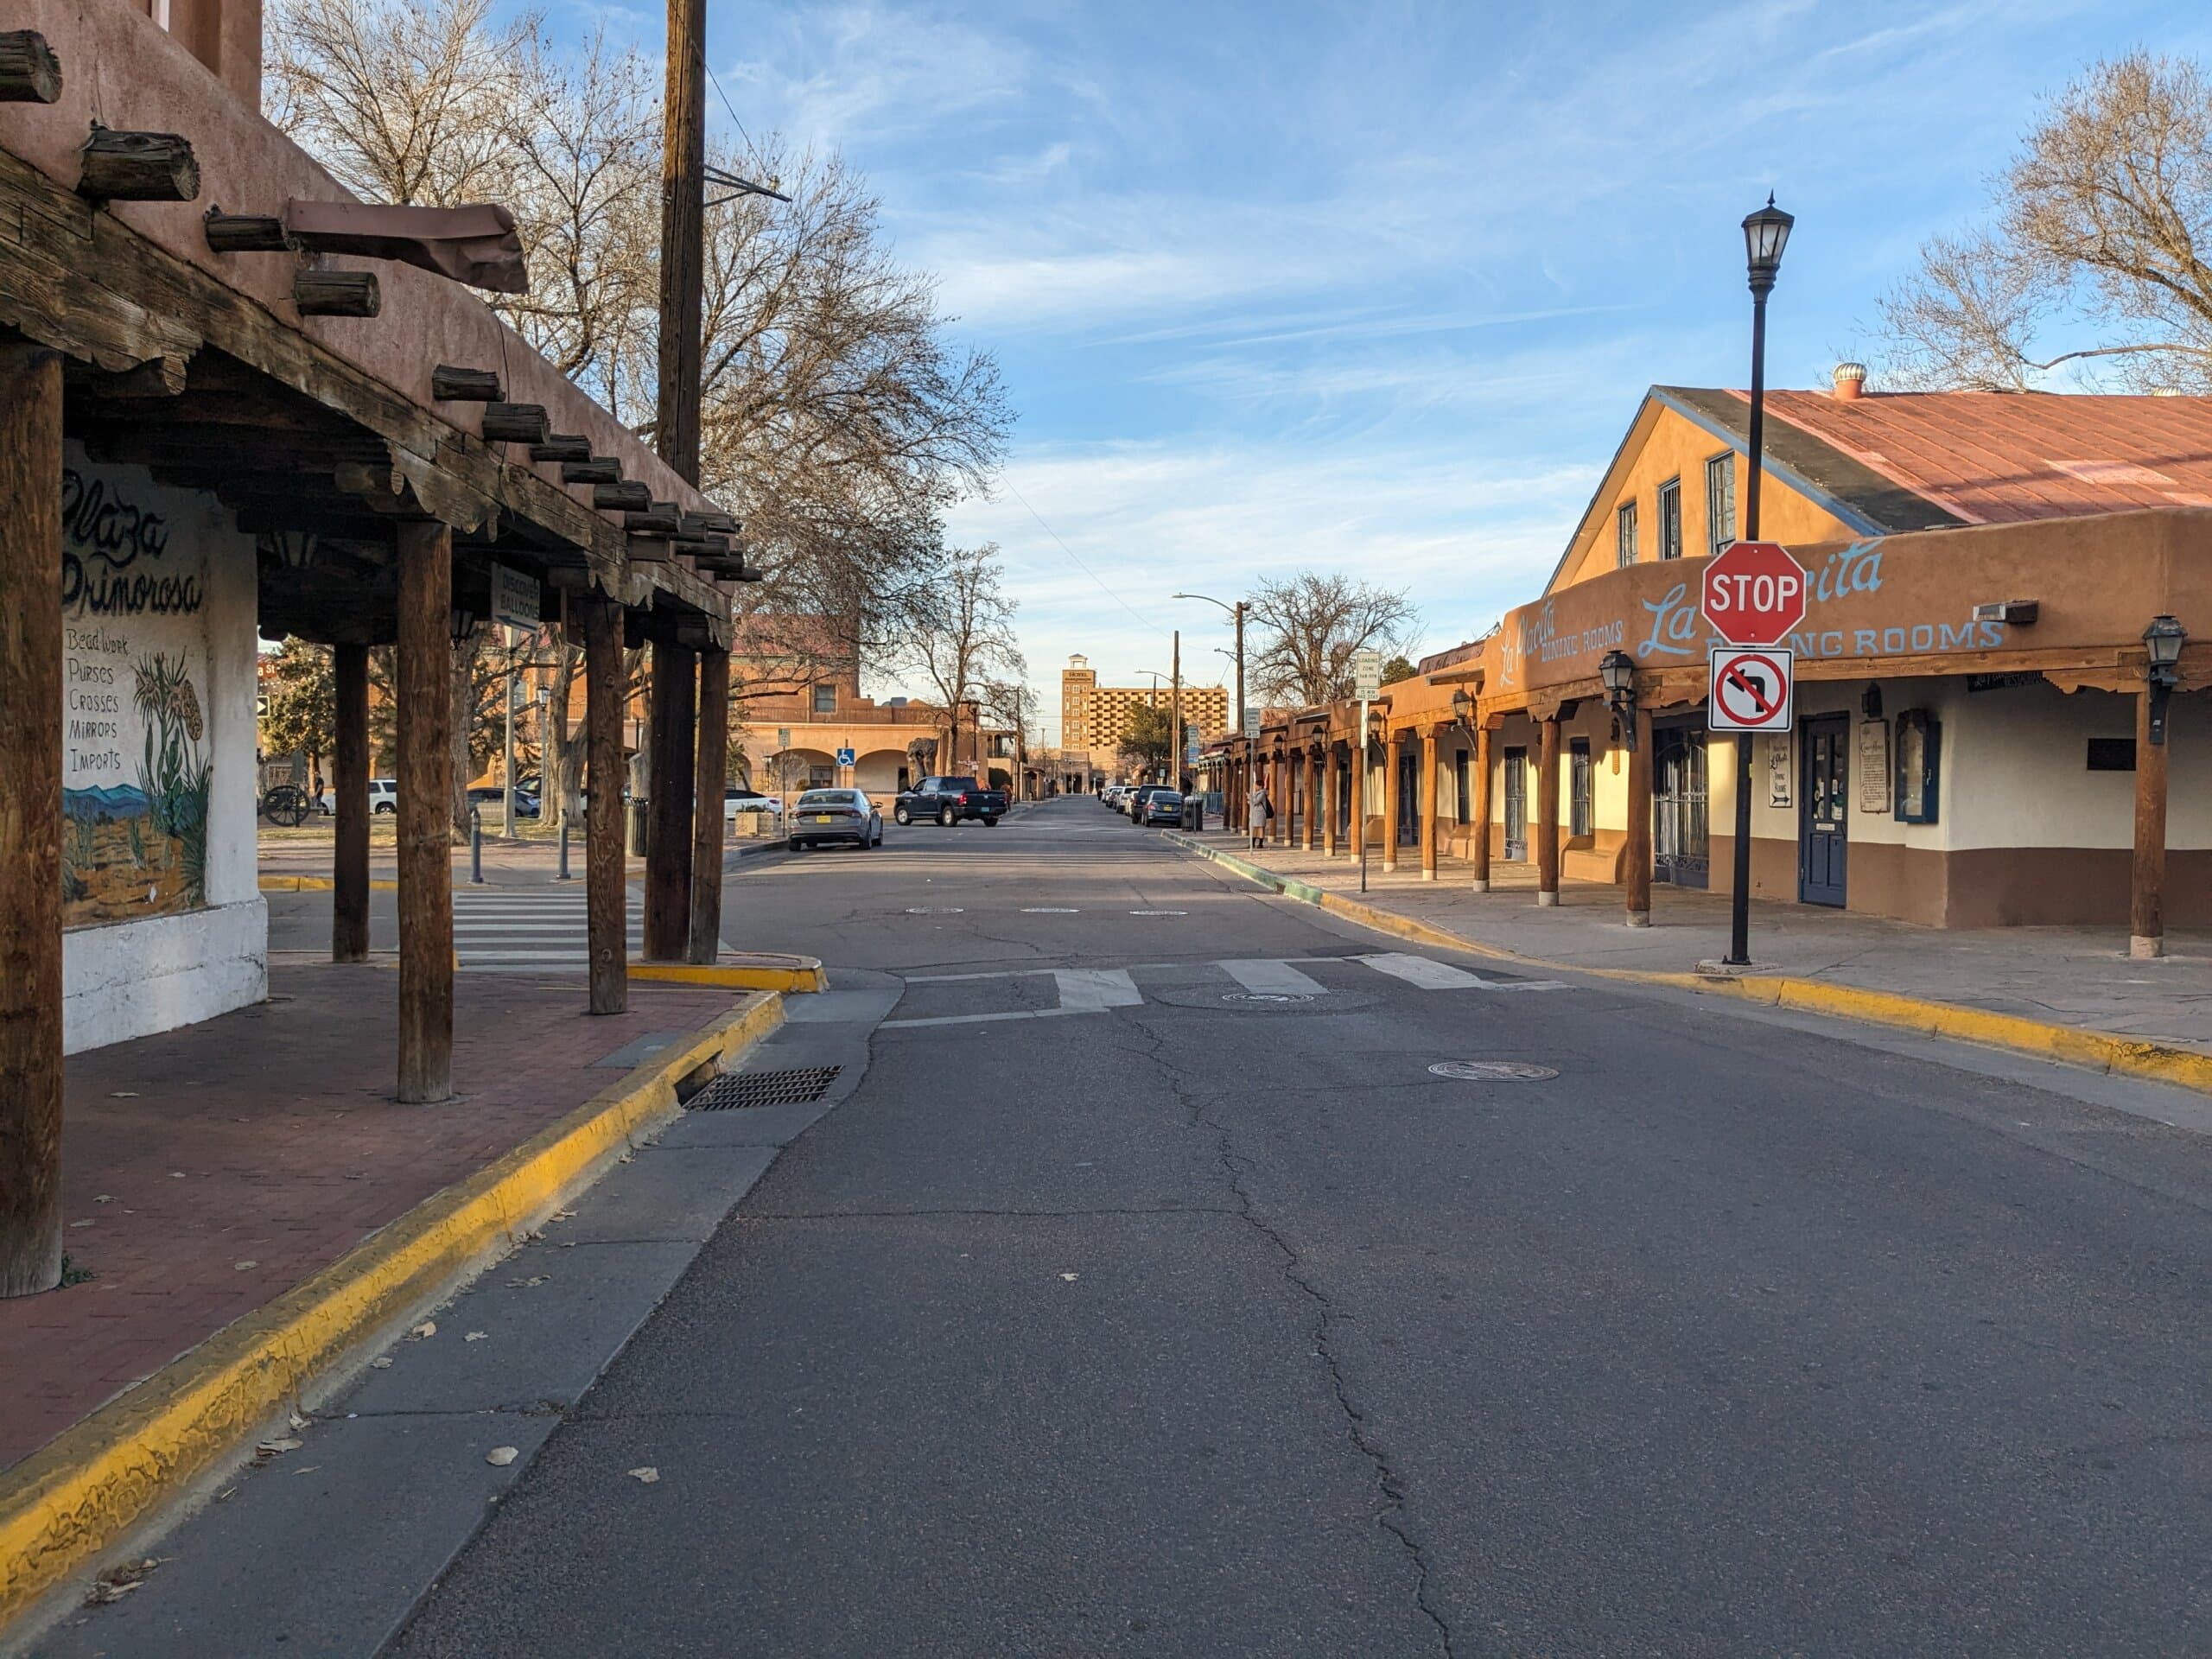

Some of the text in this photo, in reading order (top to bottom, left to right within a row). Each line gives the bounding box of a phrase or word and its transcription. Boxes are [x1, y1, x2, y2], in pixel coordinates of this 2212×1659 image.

[1710, 574, 1798, 613] STOP
[1638, 583, 1697, 658] La
[1853, 621, 2005, 655] ROOMS
[1499, 630, 1514, 689] La
[1541, 620, 1624, 663] DINING ROOMS
[266, 664, 276, 674] St
